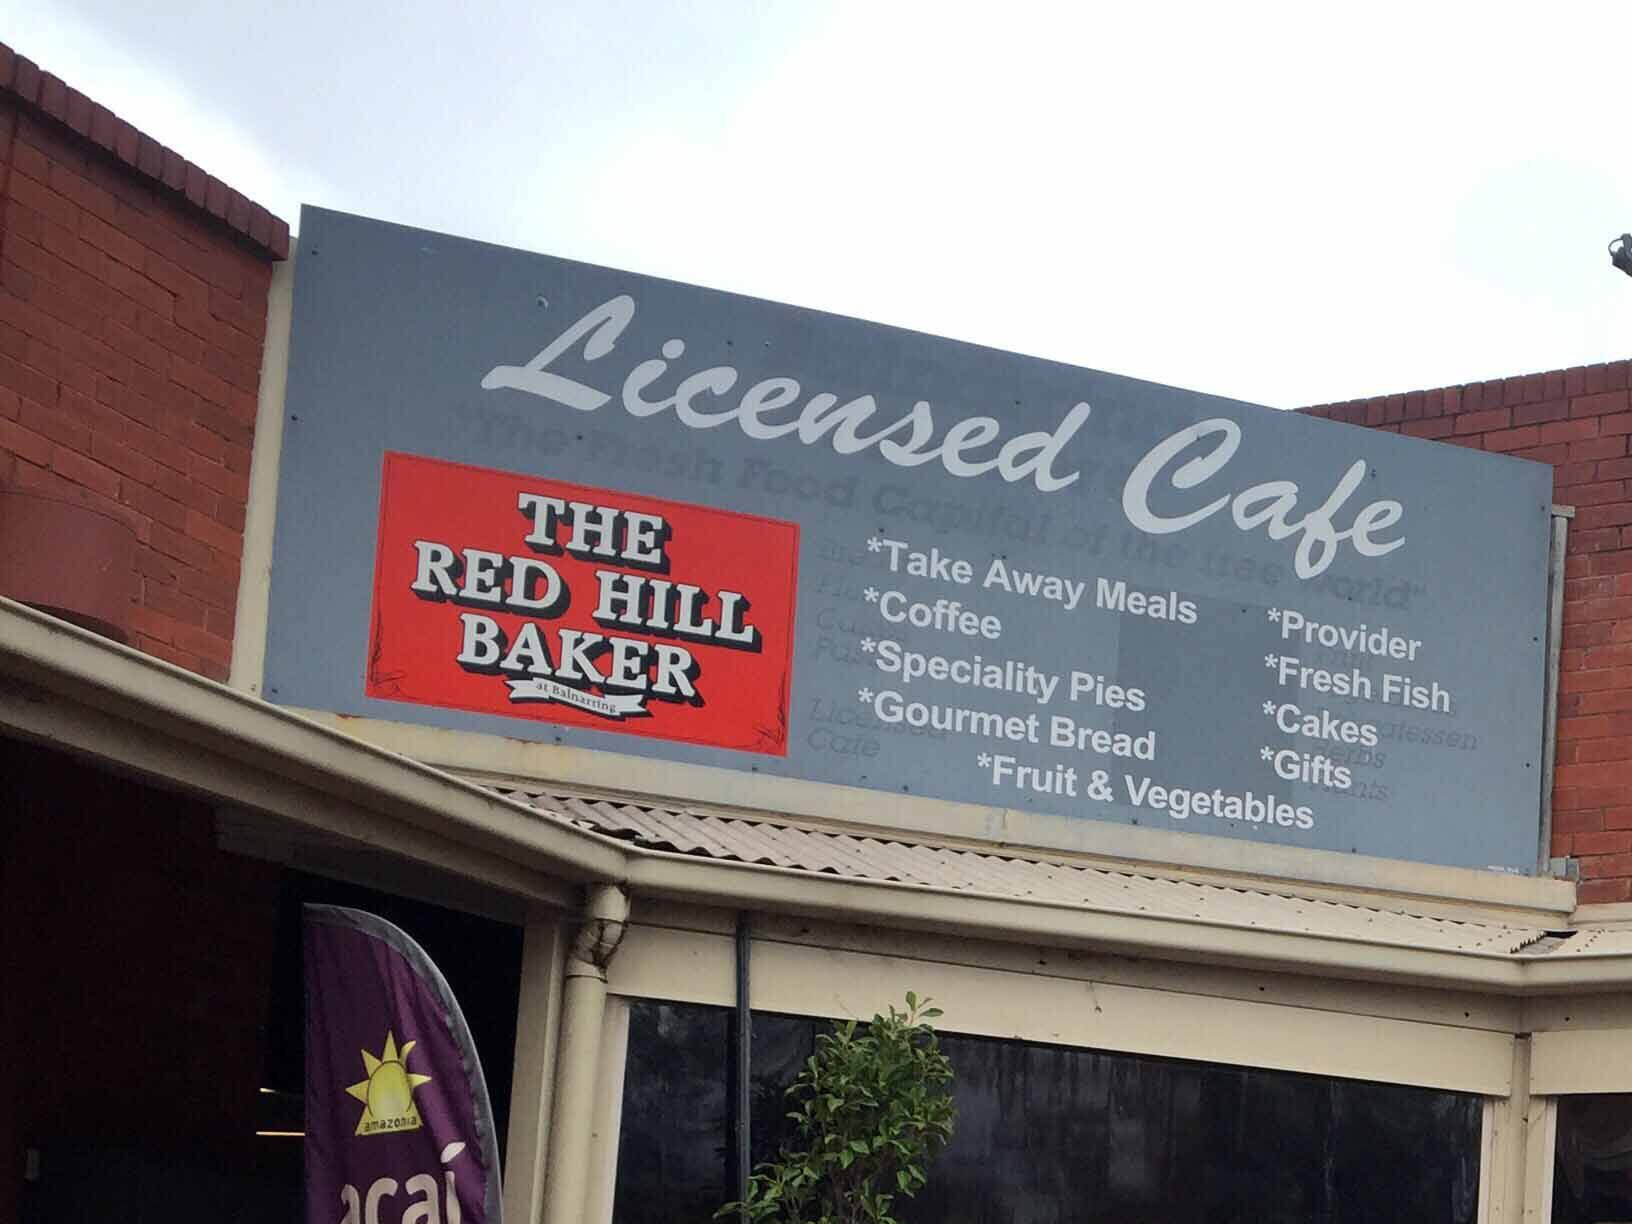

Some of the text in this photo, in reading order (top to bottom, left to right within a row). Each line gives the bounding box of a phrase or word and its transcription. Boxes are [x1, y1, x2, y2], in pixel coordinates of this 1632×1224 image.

[481, 295, 1405, 579] Licensed Cafe
[518, 492, 667, 568] THE
[410, 540, 566, 613] RED
[592, 570, 758, 647] HILL
[983, 559, 1085, 610] Away
[1096, 577, 1198, 624] Meals
[456, 612, 700, 701] BAKER
[536, 681, 616, 713] at Balnarring
[1070, 671, 1146, 712] Pies
[1382, 673, 1451, 713] Fish
[1050, 715, 1156, 761] Bread
[1087, 769, 1114, 802] &
[1125, 774, 1314, 830] Vegetables
[364, 1116, 417, 1132] amazonia
